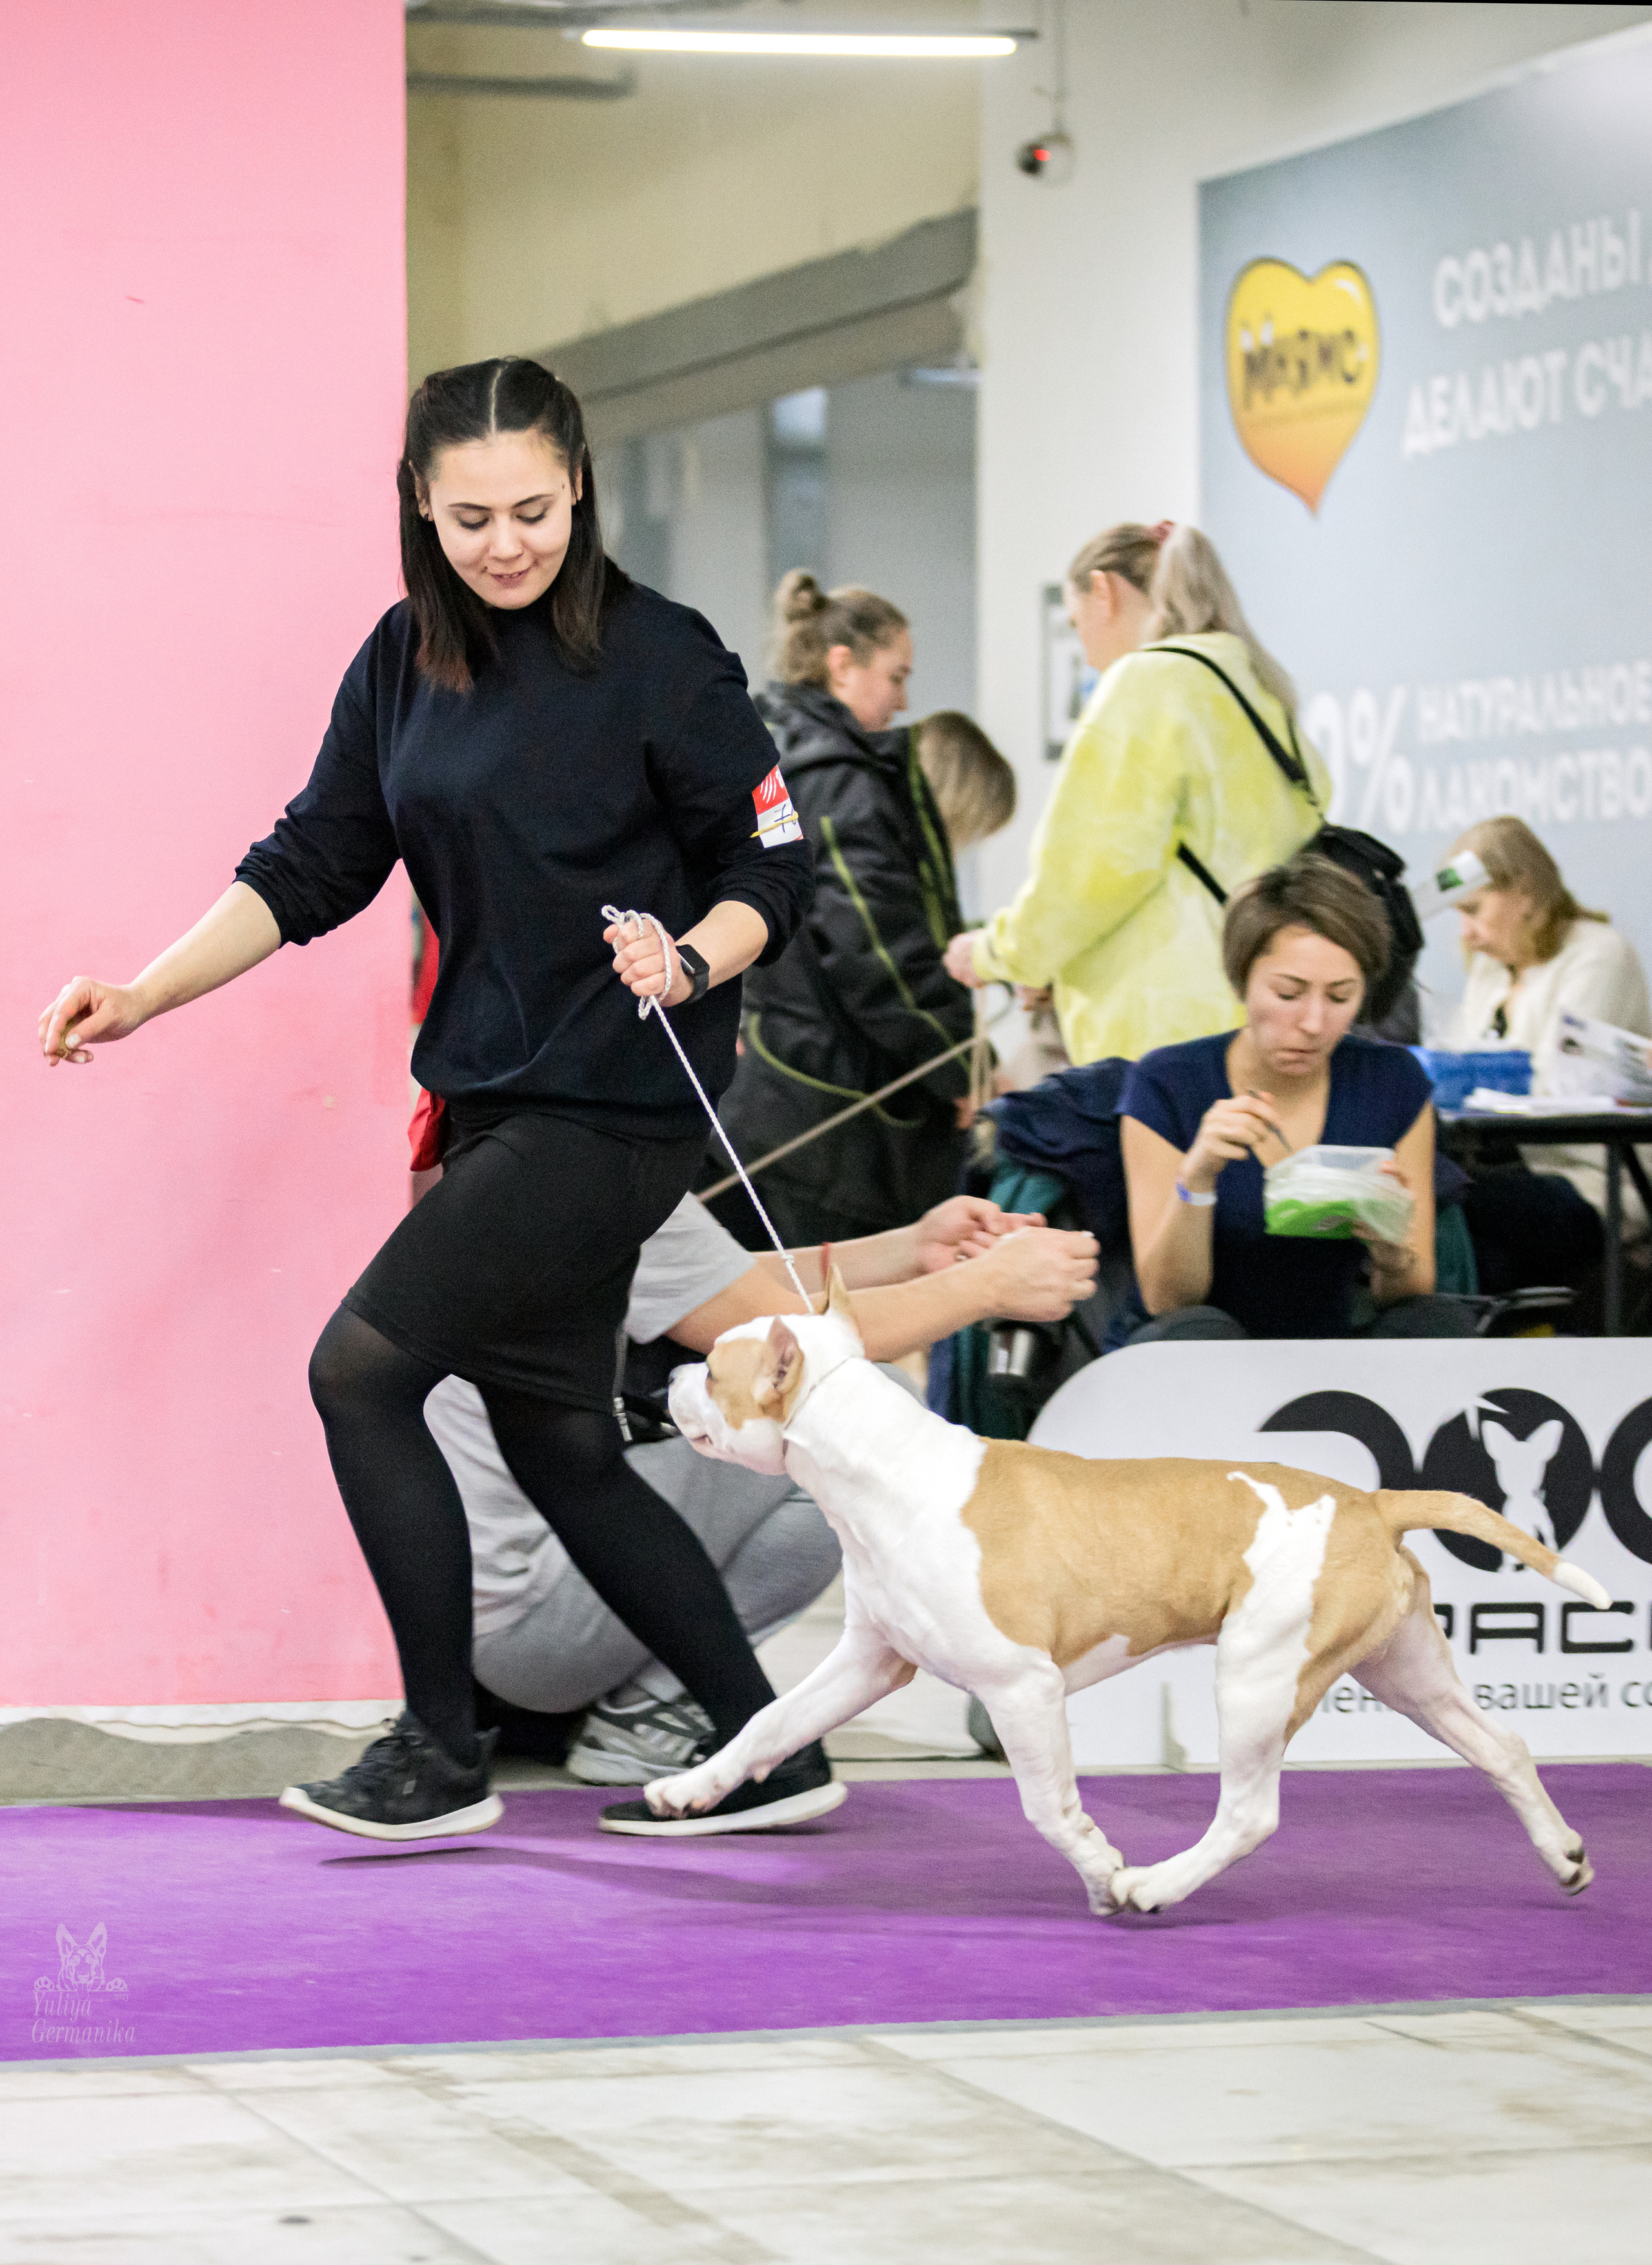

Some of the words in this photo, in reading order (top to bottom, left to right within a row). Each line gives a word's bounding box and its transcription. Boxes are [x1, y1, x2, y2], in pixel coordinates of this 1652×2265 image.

[1434, 210, 1641, 328] СОЗДАНЫ
[1402, 348, 1567, 461] ДЕЛАЮТ
[1473, 1672, 1609, 1710] вашей
